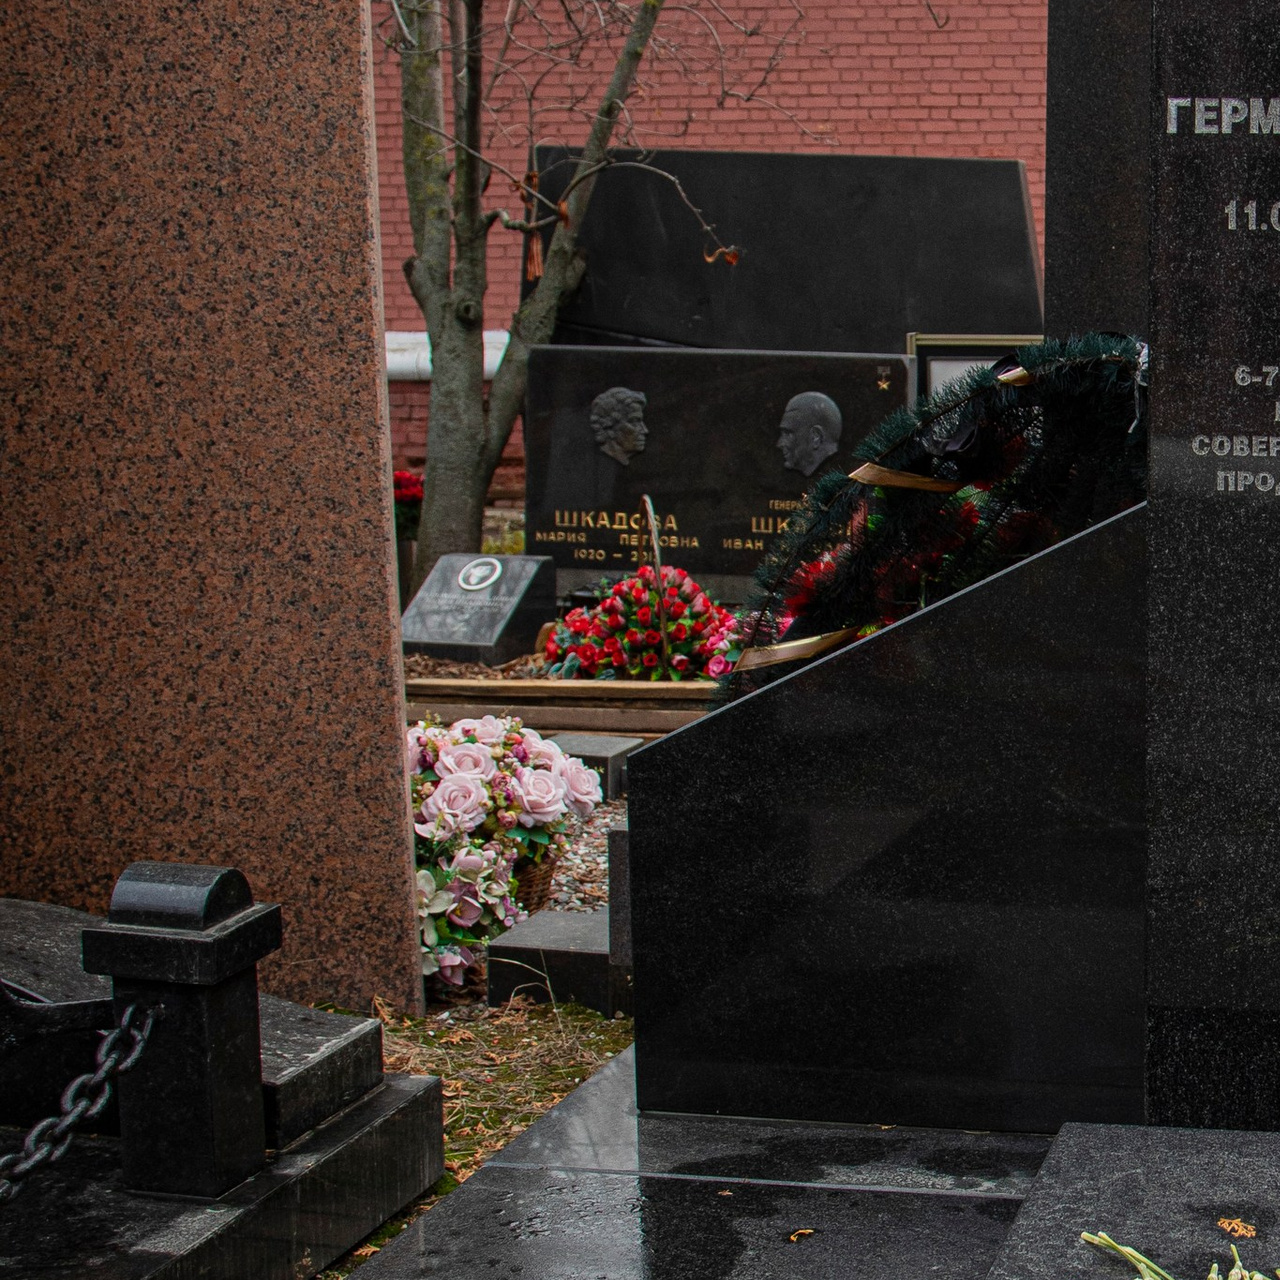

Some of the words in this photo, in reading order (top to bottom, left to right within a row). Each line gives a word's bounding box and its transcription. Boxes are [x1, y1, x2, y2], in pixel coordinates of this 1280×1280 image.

[1235, 365, 1277, 390] 6-7
[535, 531, 587, 543] МАРИЯ
[723, 538, 764, 550] ИВАН
